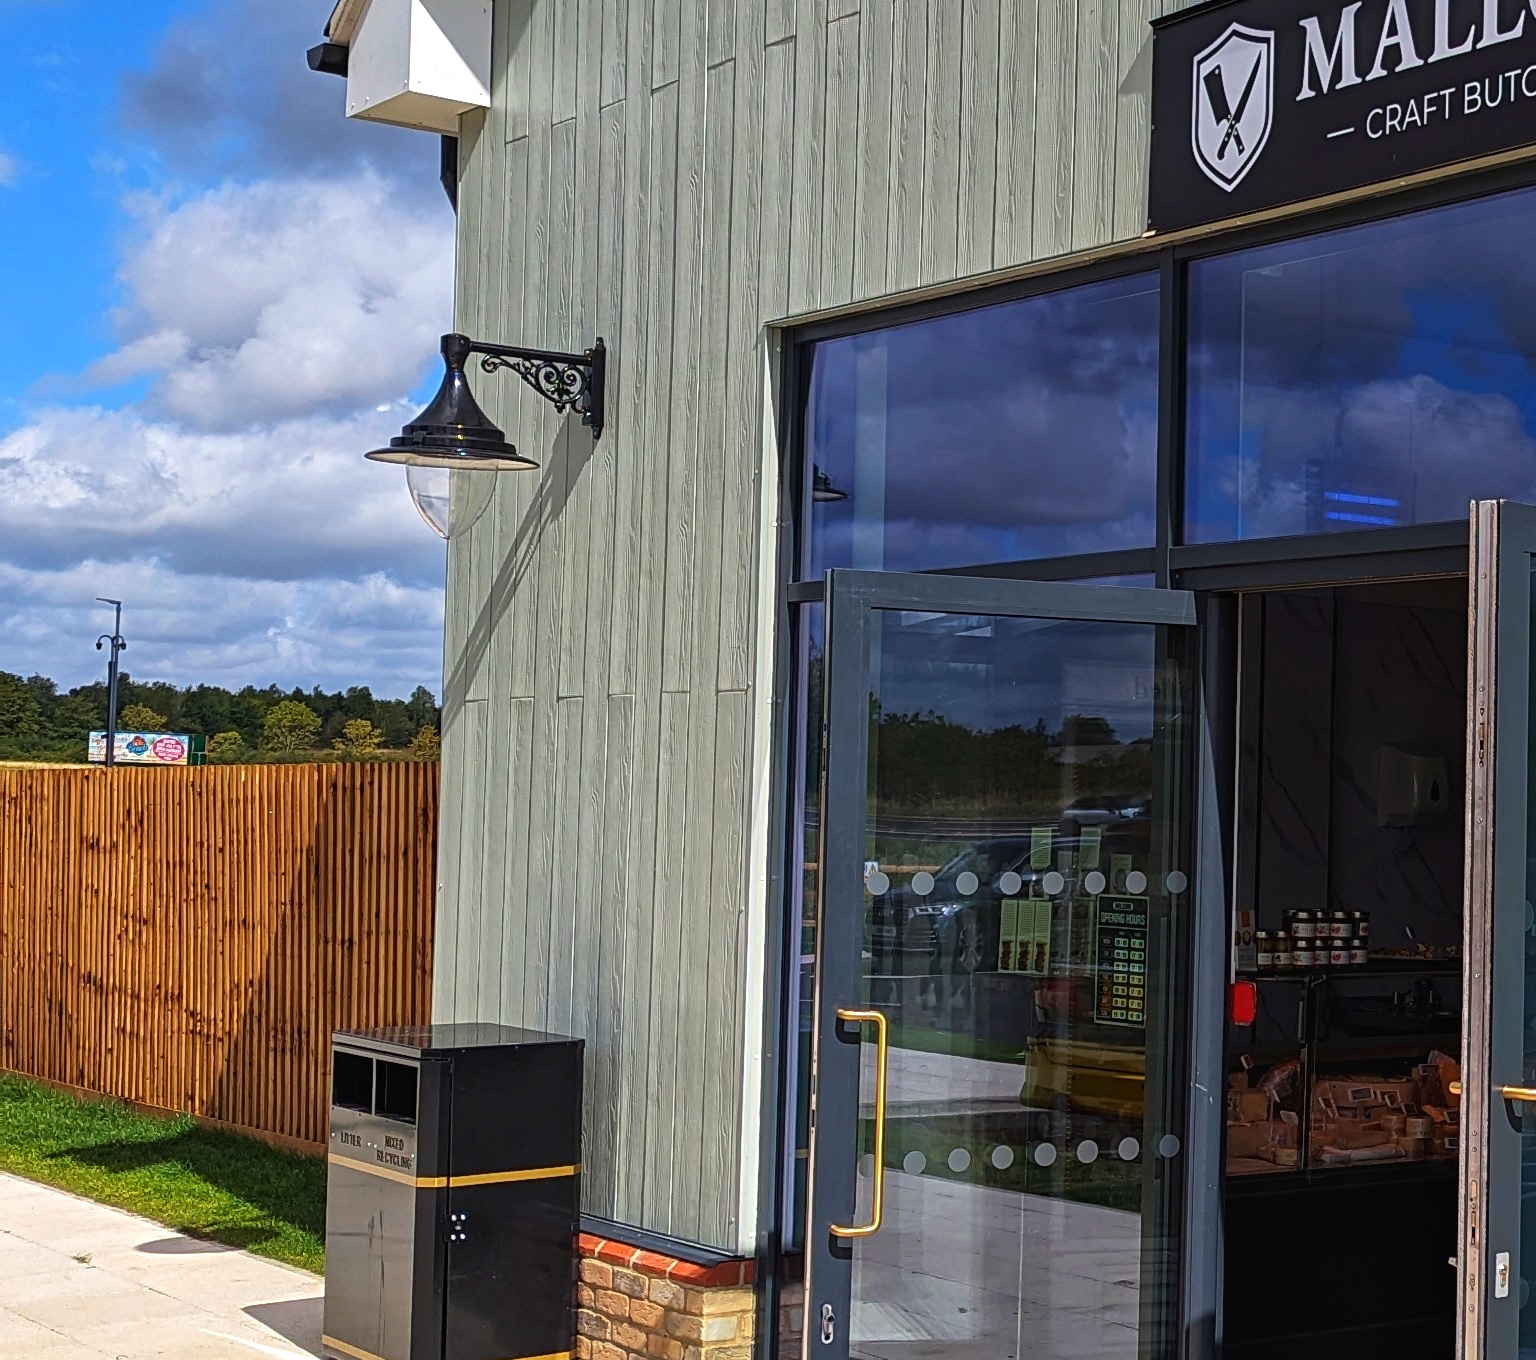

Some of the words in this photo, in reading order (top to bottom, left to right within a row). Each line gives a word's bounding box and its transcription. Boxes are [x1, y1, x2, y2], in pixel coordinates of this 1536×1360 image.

[1365, 86, 1456, 139] CRAFT
[341, 1131, 362, 1148] LITTER
[385, 1135, 405, 1151] MIXED
[377, 1149, 412, 1170] RECYCLING
